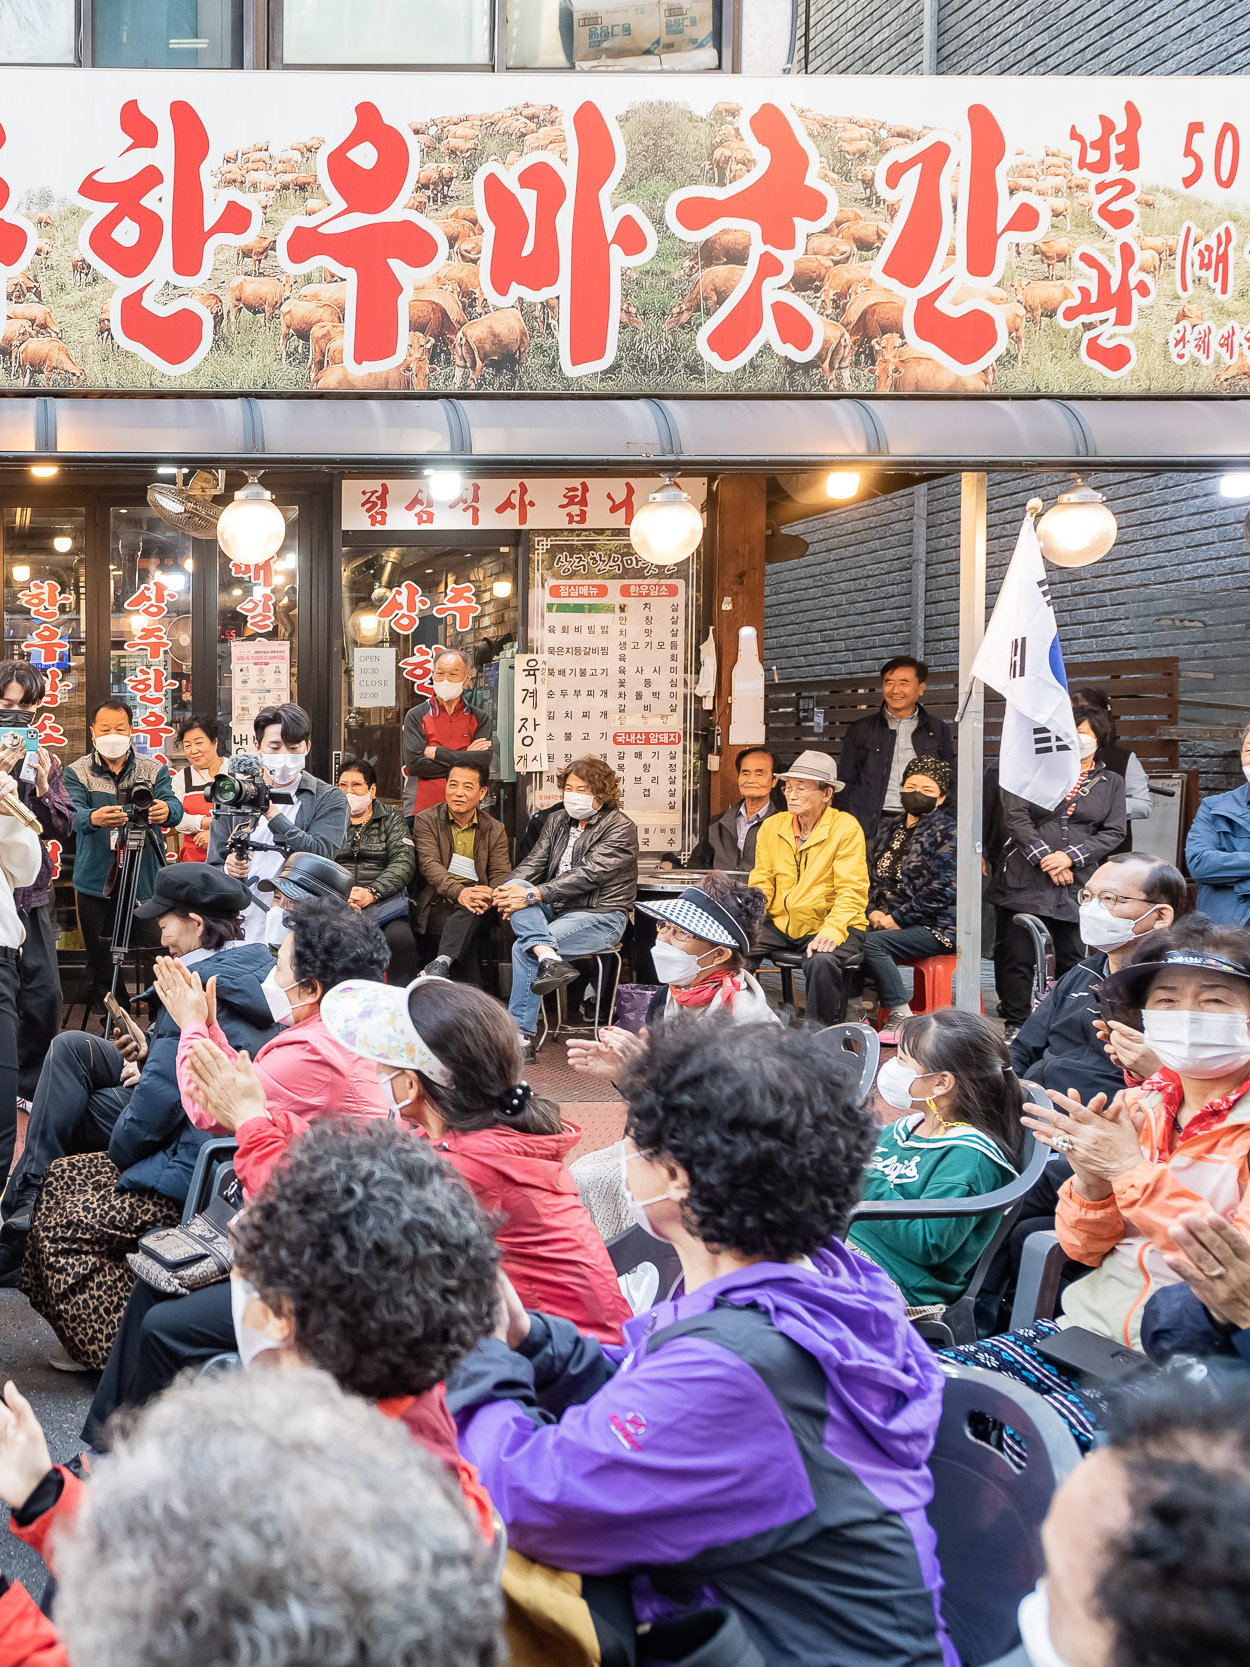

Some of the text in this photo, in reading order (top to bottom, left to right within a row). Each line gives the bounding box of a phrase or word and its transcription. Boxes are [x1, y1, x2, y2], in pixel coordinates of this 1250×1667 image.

[1062, 100, 1151, 372] 별관
[558, 585, 670, 597] 점심메뉴 한우암소
[232, 556, 276, 642] 매일
[377, 582, 480, 633] 상주
[359, 667, 379, 675] 10:30
[518, 658, 541, 747] 육계장
[546, 710, 608, 720] 김치찌개
[546, 732, 608, 741] 소불고기
[615, 732, 679, 744] 국내산 암돼지
[516, 752, 543, 768] 개시
[617, 751, 677, 760] 갈매기살
